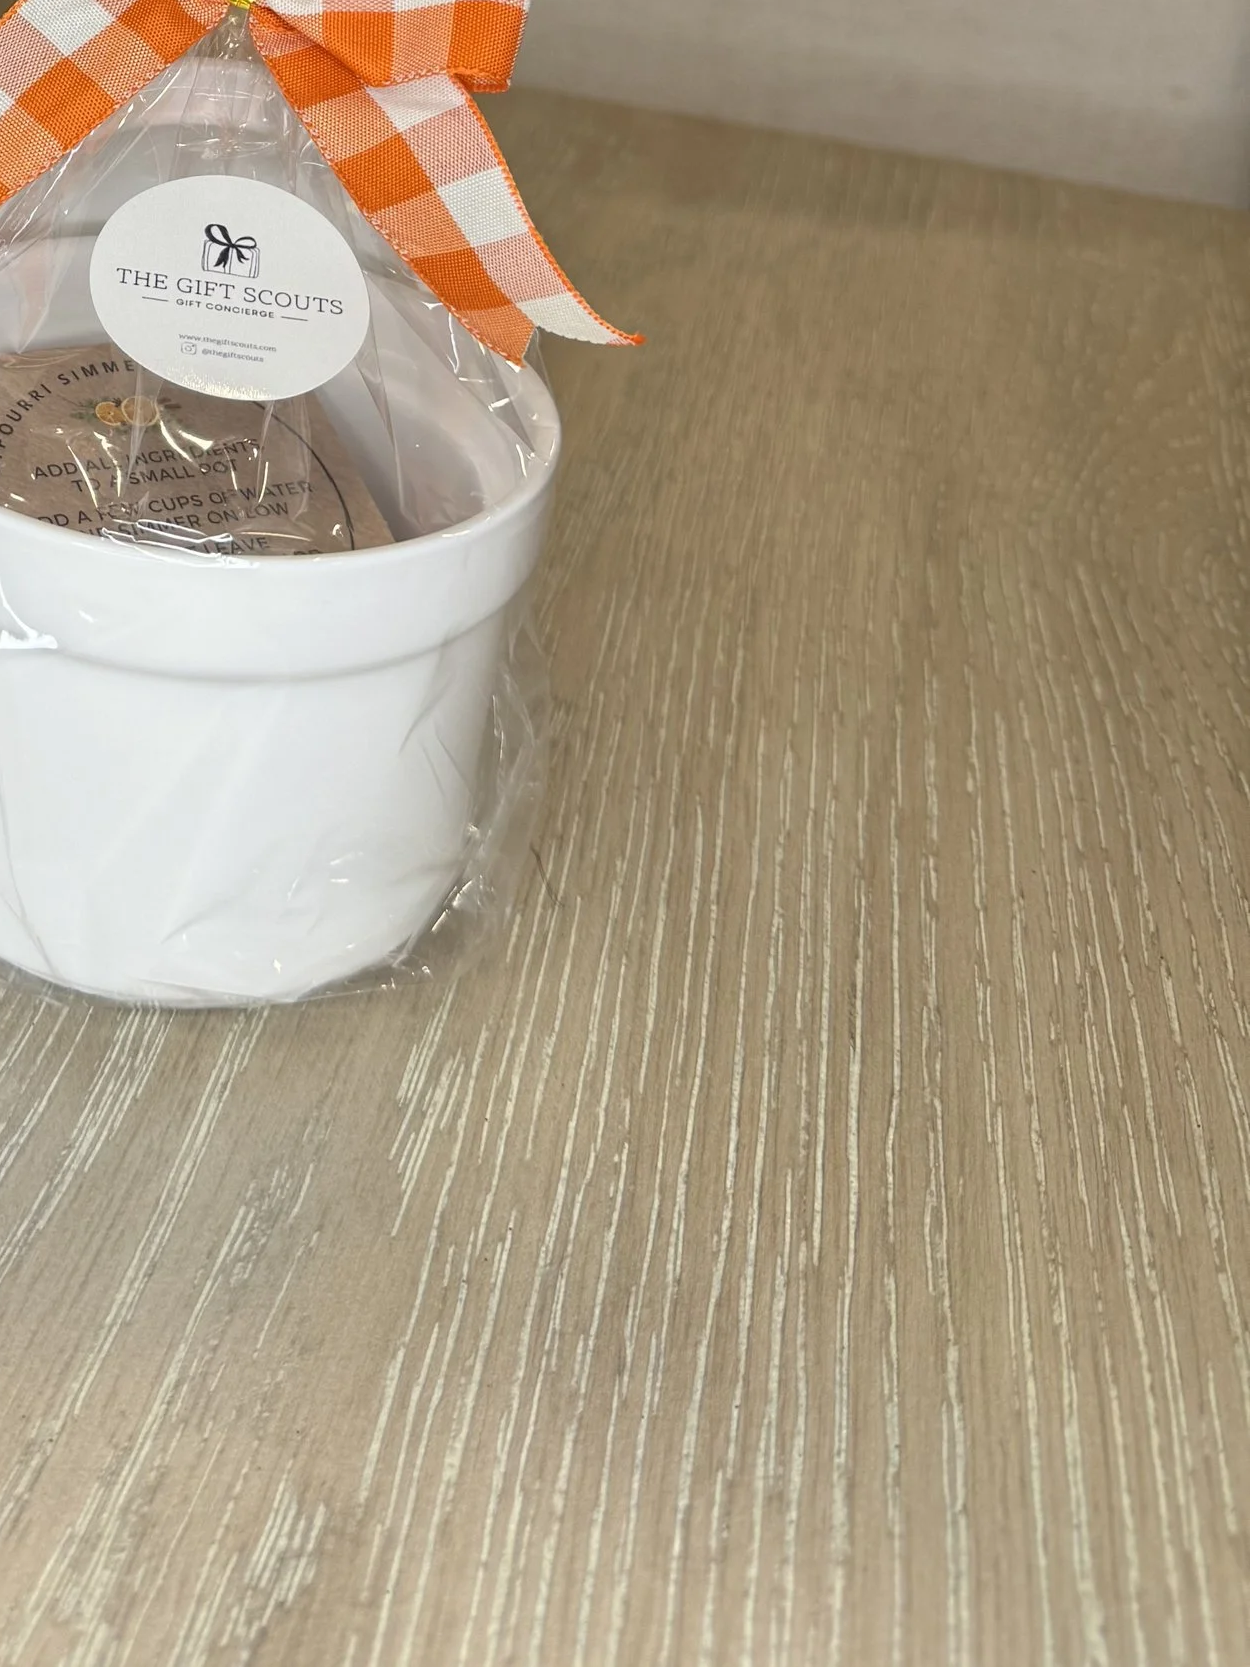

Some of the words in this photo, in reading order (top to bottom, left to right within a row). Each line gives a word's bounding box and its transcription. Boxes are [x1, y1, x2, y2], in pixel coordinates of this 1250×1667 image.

[116, 267, 168, 291] THE
[176, 277, 236, 300] GIFT
[243, 287, 344, 315] SCOUTS
[176, 298, 202, 309] GIFT
[205, 302, 276, 319] CONCIERGE
[178, 333, 277, 352] www.thegiftscouts.com
[201, 347, 264, 362] @thegiftscouts
[57, 359, 135, 386] SIMME
[34, 462, 78, 479] ADD
[71, 478, 101, 492] TO
[129, 467, 195, 485] SMALL
[201, 459, 238, 475] POT
[78, 510, 92, 524] A
[148, 494, 203, 513] CUPS
[209, 489, 235, 504] OF
[237, 482, 314, 501] WATER
[207, 509, 239, 524] ON
[246, 502, 289, 519] LOW
